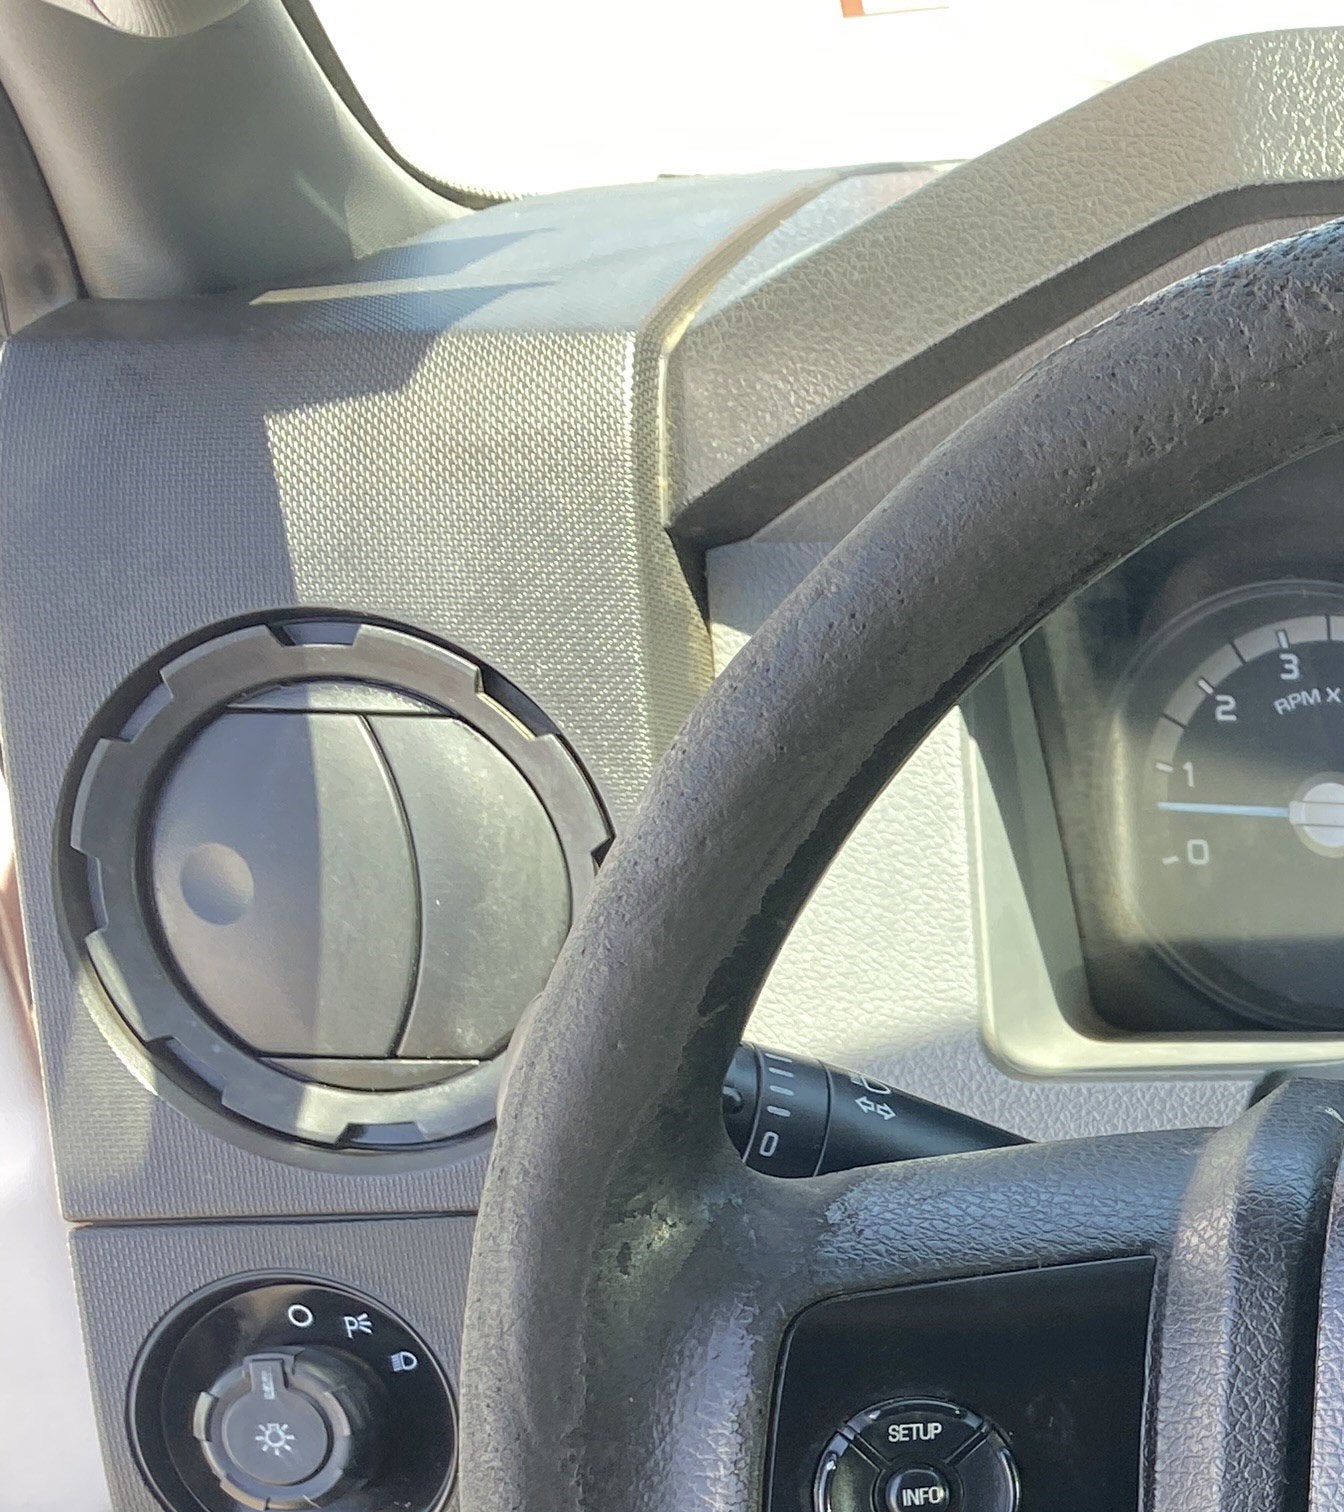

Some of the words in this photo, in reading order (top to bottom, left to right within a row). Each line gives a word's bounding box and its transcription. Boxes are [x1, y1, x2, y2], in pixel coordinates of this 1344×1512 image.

[1279, 653, 1300, 680] 3
[1215, 696, 1236, 721] 2
[1273, 688, 1322, 715] RPM
[1326, 687, 1341, 703] X
[1183, 762, 1195, 788] 1
[1187, 839, 1209, 865] 0
[888, 1422, 943, 1443] SETUP
[902, 1487, 944, 1507] INFO
